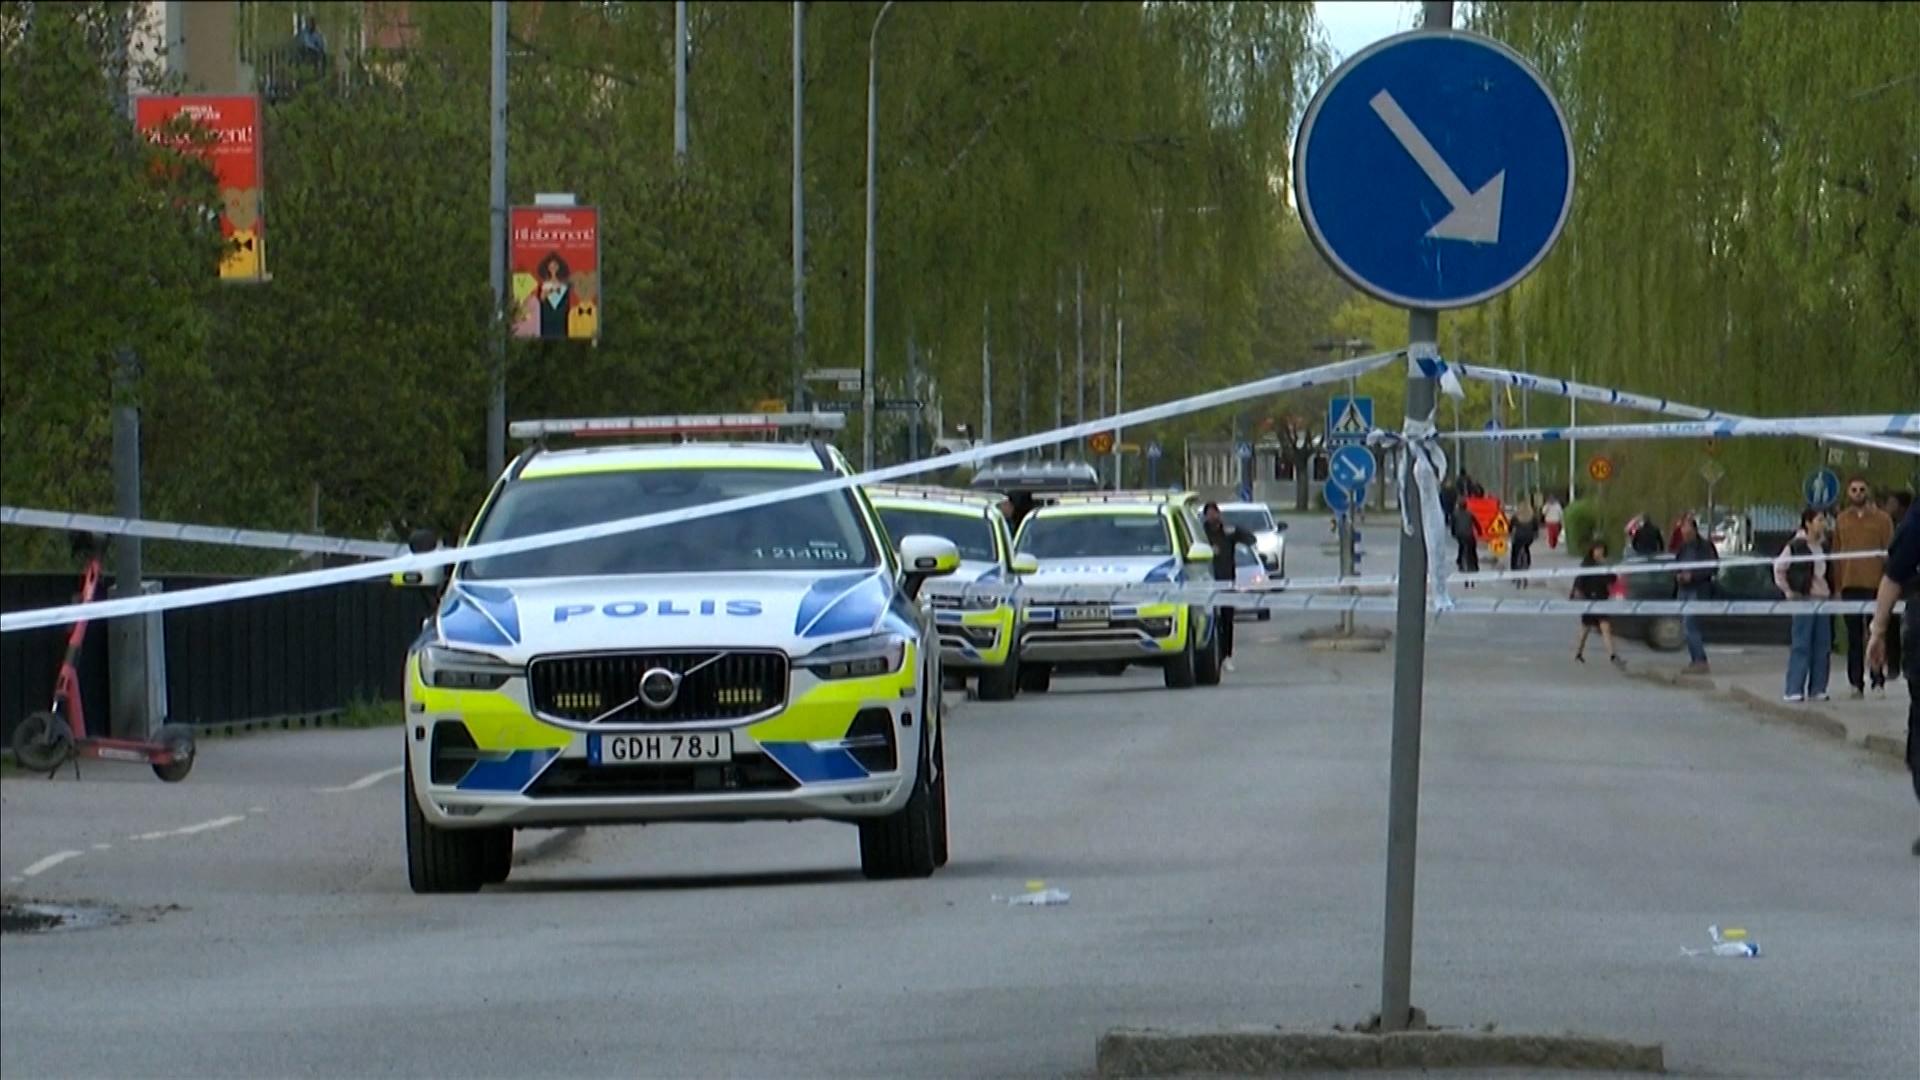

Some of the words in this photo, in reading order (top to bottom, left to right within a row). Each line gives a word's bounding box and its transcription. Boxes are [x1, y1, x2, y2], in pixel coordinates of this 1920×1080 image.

[553, 599, 763, 623] POLIS
[611, 736, 661, 760] GDH
[670, 735, 720, 760] 78J
